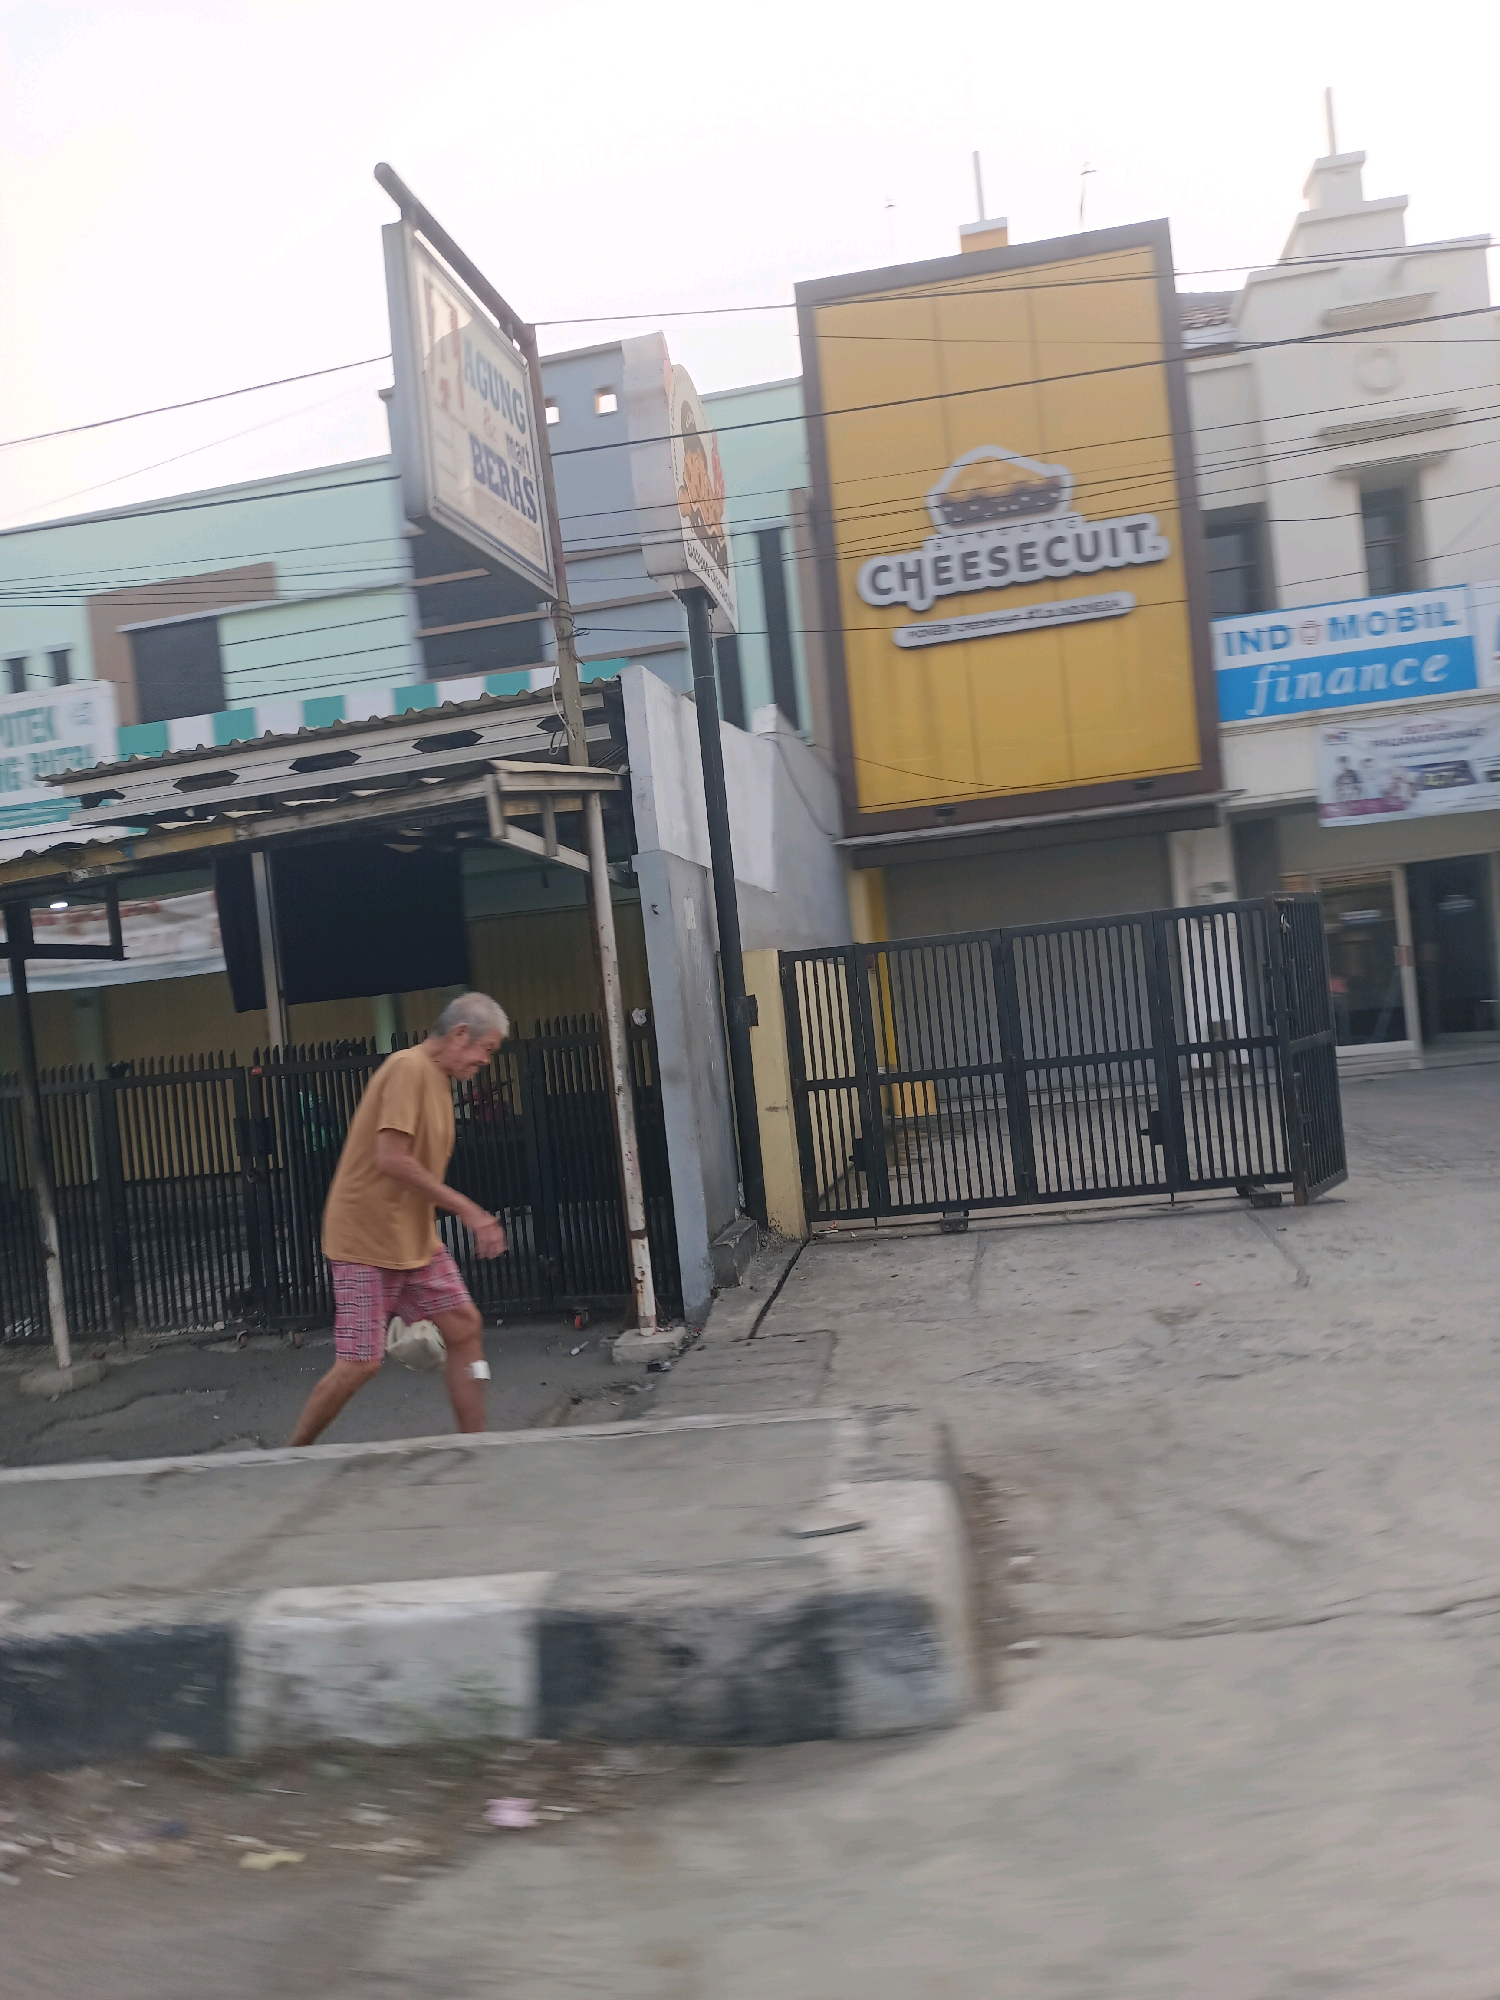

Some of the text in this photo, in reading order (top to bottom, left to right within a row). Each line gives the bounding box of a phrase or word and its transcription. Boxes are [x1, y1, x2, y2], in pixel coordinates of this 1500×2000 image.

[464, 337, 527, 435] AGUNG
[470, 431, 537, 524] BERAS
[506, 432, 531, 473] mart
[870, 522, 1150, 600] CHEESECUIT
[1246, 654, 1450, 716] finance
